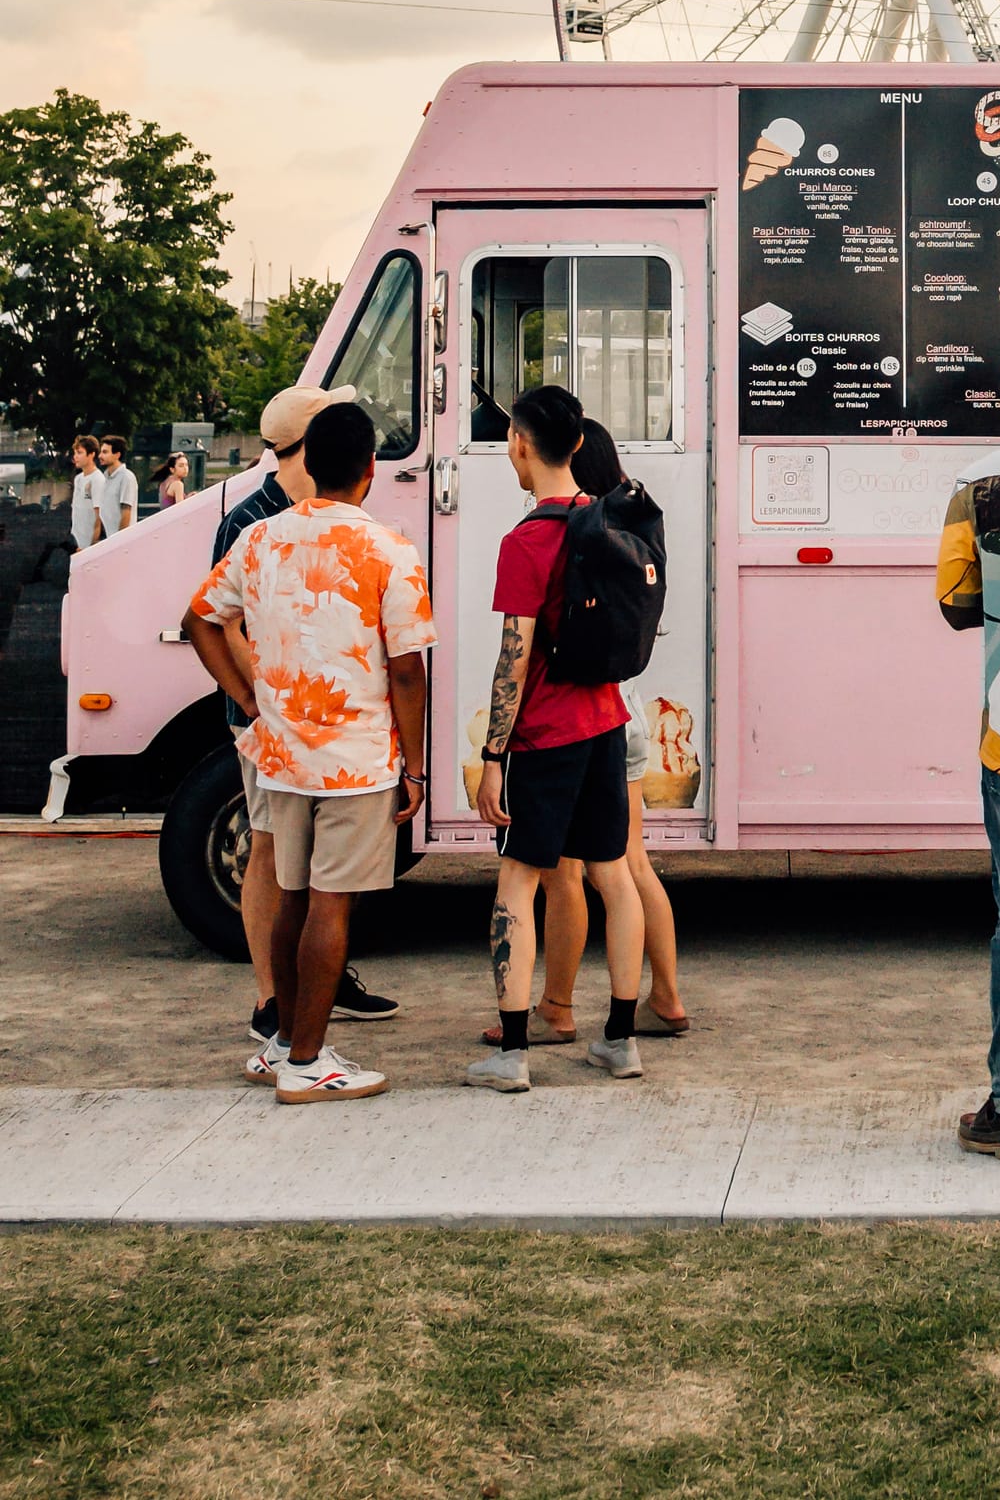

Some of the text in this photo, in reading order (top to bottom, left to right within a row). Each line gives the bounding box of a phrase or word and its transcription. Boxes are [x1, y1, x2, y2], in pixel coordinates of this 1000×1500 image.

[880, 93, 922, 104] MENU
[784, 168, 876, 177] CHURROS CONES
[799, 183, 820, 193] Papi
[823, 183, 852, 191] Marco
[947, 198, 976, 206] LOOP
[919, 220, 966, 230] schtroumpf
[753, 227, 774, 236] Papi
[776, 226, 810, 236] Christo
[842, 225, 864, 235] Papi
[865, 226, 891, 235] Tonio
[785, 333, 880, 342] BOITES CHURROS
[811, 347, 847, 355] Classic
[926, 344, 969, 353] Candiloop
[776, 364, 788, 372] de
[798, 364, 815, 372] 10$
[860, 362, 871, 370] de
[882, 362, 898, 370] 15$
[965, 390, 996, 399] Classic
[860, 420, 948, 428] LESPAPICHURROS
